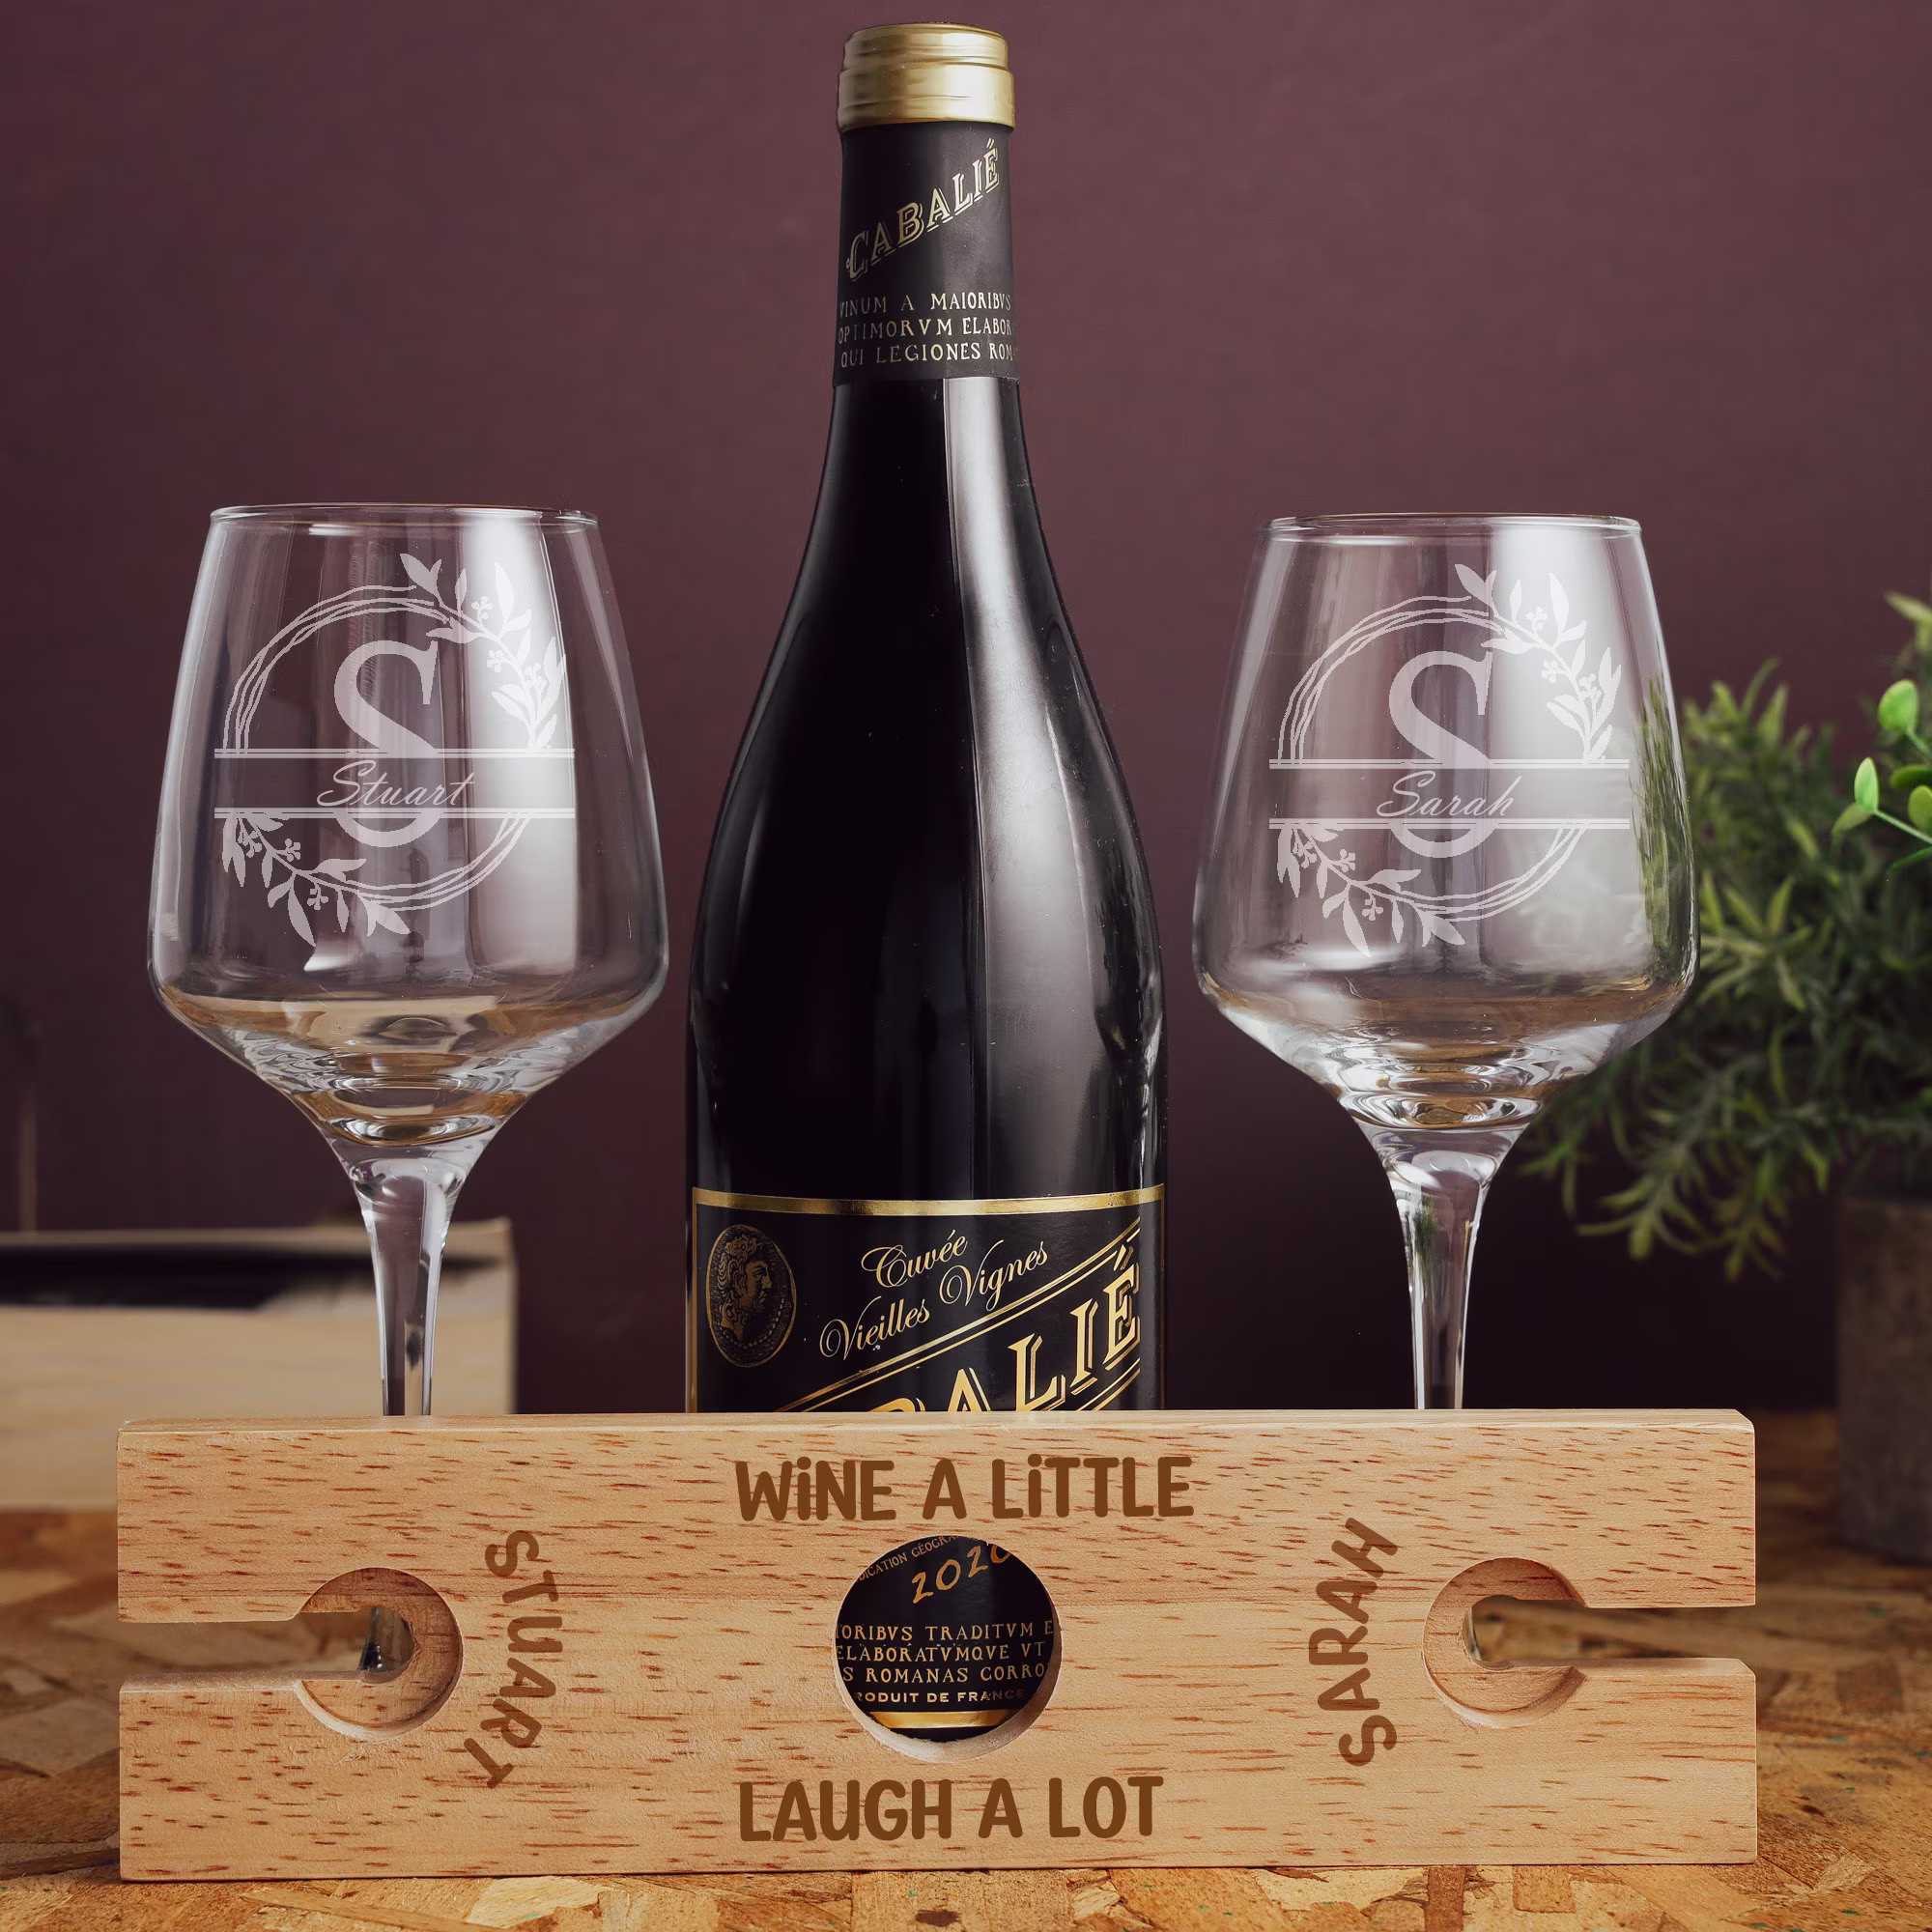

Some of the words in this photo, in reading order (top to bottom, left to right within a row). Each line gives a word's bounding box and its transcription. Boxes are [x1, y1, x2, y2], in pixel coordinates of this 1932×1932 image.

[845, 137, 1000, 281] CABALIÉ
[839, 295, 887, 318] VINUM
[900, 294, 915, 311] A
[930, 292, 1011, 311] MAIORIBVS
[840, 348, 864, 368] QUI
[876, 342, 981, 363] LEGIONES
[317, 759, 475, 808] Stuart
[1376, 770, 1522, 817] Sarah
[861, 1229, 968, 1288] Cuvée
[819, 1295, 930, 1361] Vieilles
[939, 1239, 1048, 1311] Vignes
[869, 1244, 1142, 1412] ALIÉ
[922, 1458, 967, 1520] A
[857, 1551, 909, 1582] DICATION
[924, 1622, 1034, 1641] TRADITVM
[1021, 1641, 1045, 1658] VT
[1308, 1517, 1399, 1766] SARAH
[464, 1530, 563, 1789] STUART
[866, 1667, 969, 1683] ROMANAS
[926, 1691, 950, 1703] DE
[957, 1688, 1026, 1702] FRANCE
[739, 1778, 952, 1842] LAUGH
[978, 1777, 1023, 1838] A
[1048, 1776, 1164, 1838] LOT
